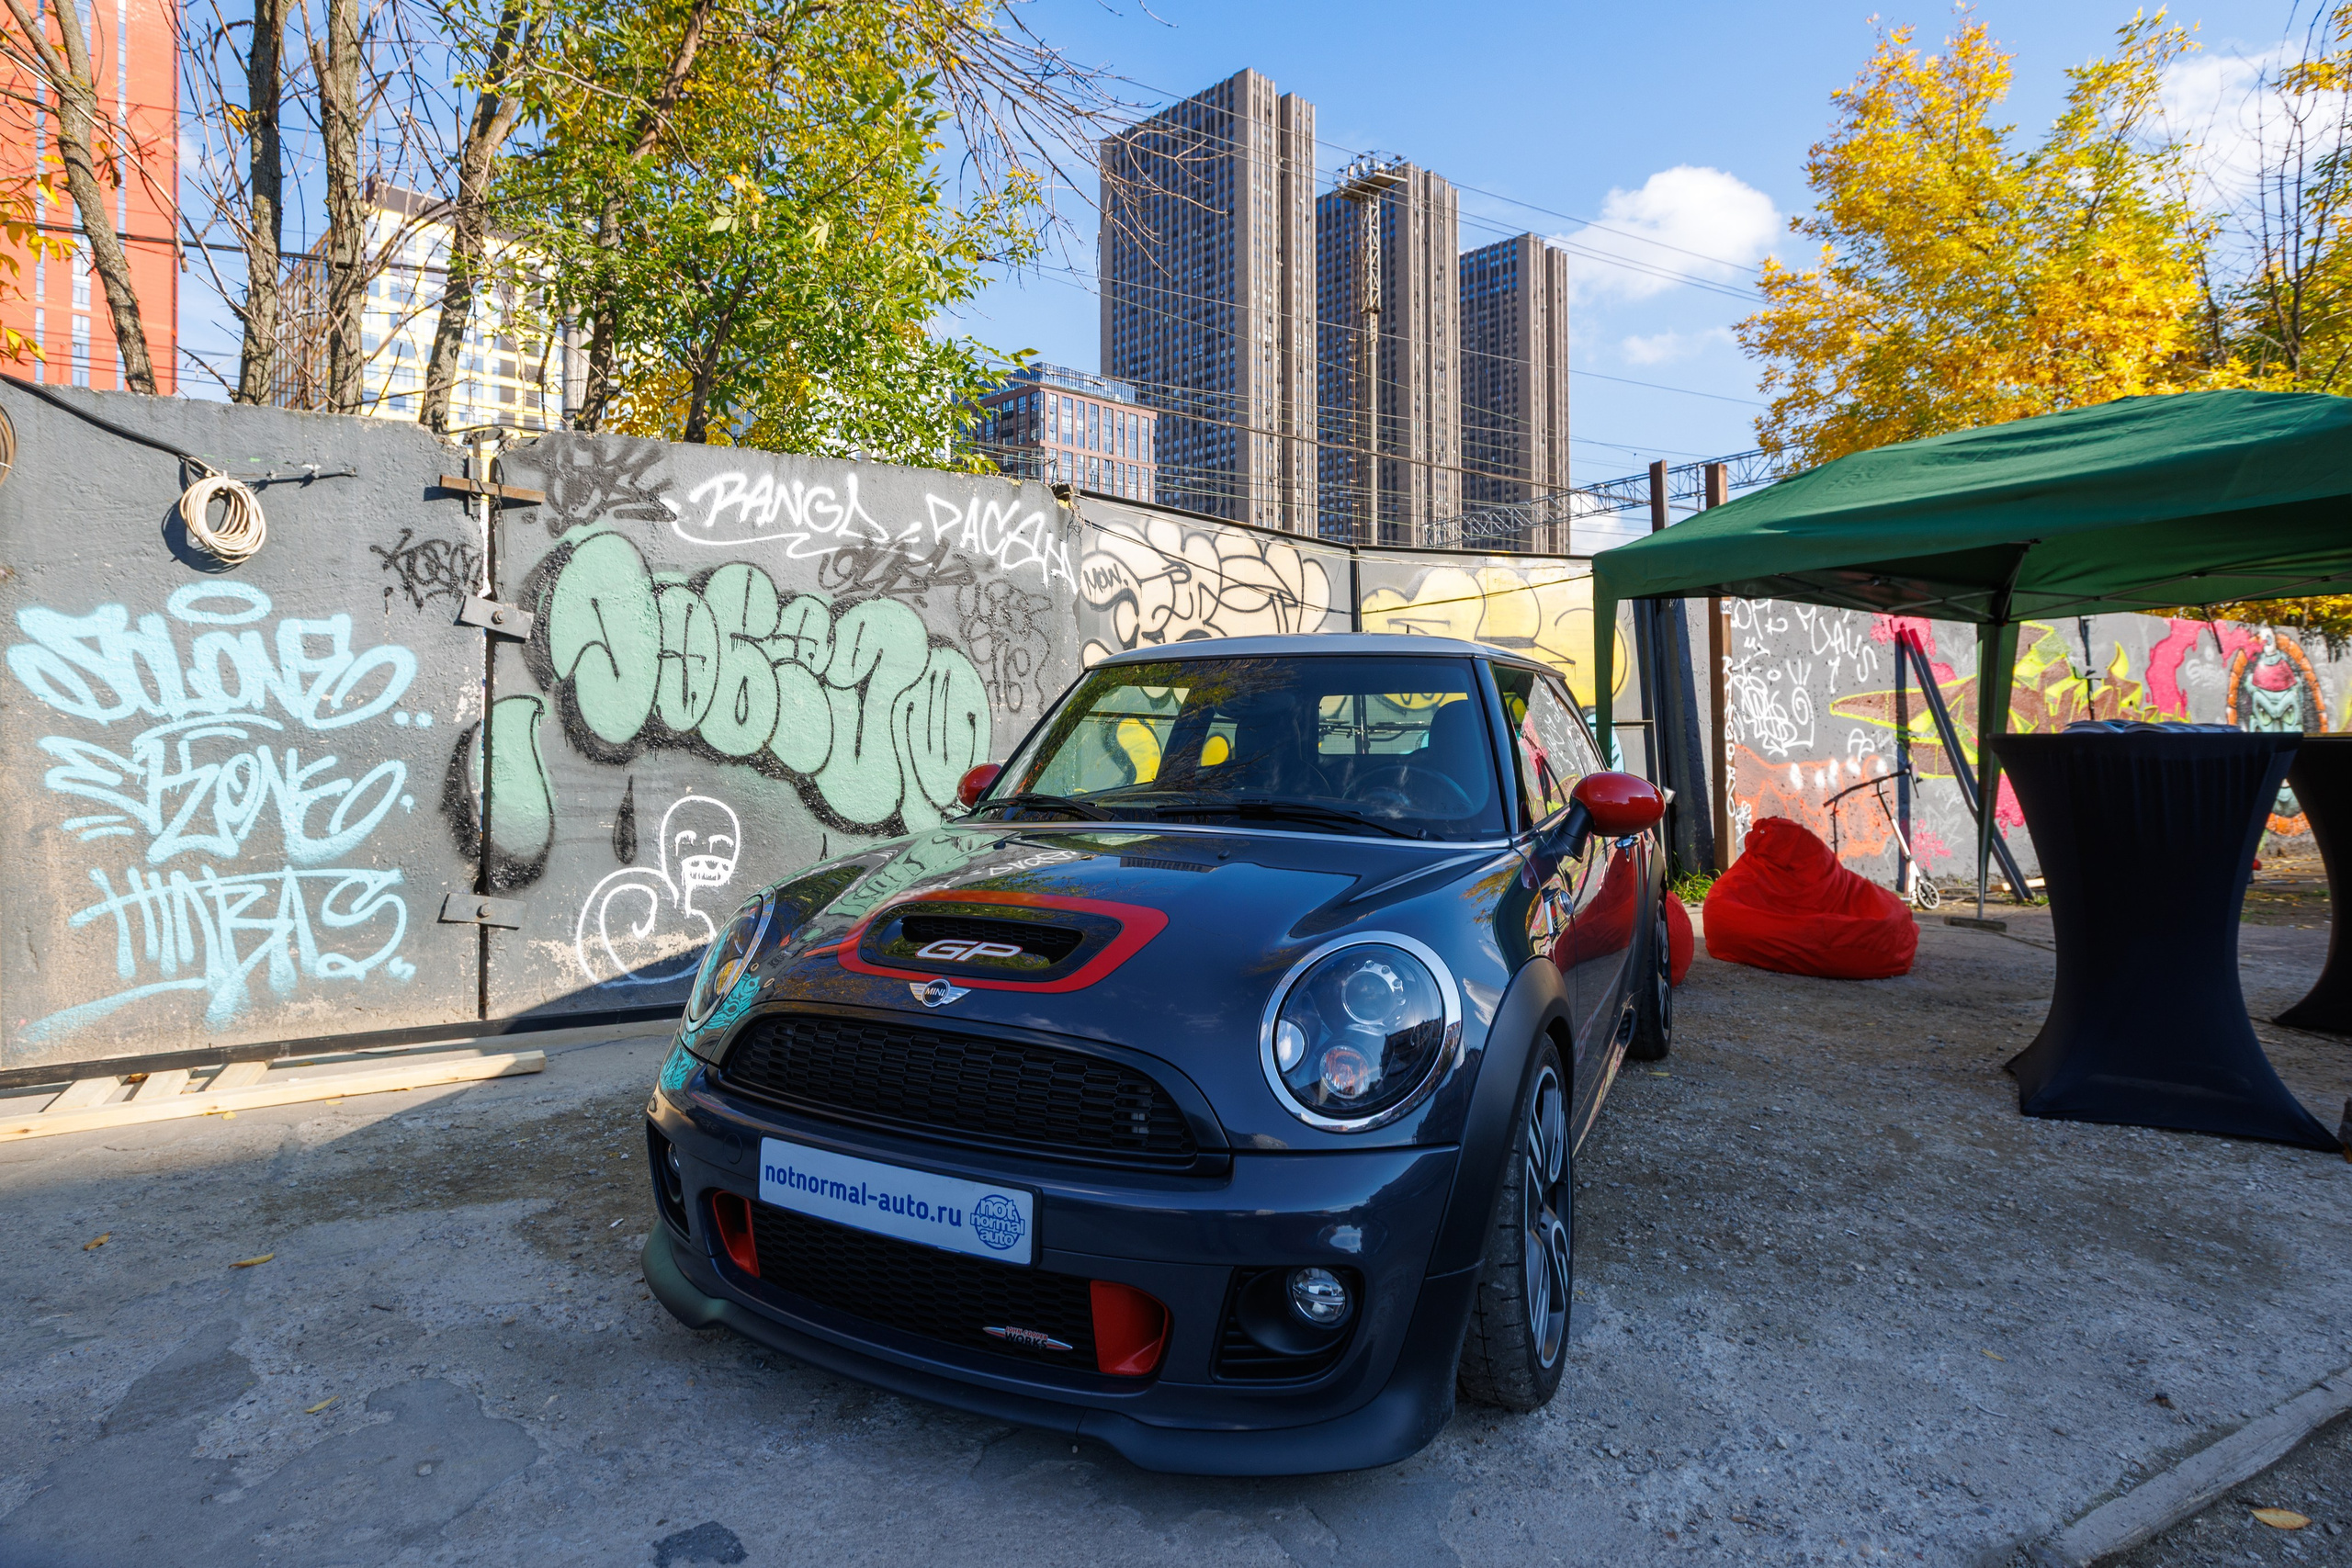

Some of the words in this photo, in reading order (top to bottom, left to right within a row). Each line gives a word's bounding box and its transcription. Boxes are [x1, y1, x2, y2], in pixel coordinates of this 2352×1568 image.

[915, 939, 1023, 962] GP
[924, 987, 946, 998] MINI
[764, 1163, 963, 1228] notnormal-auto.ru
[979, 1198, 1017, 1221] not
[970, 1213, 1025, 1236] normal
[979, 1230, 1016, 1247] auto
[1004, 1332, 1048, 1349] WORKS
[1005, 1325, 1023, 1336] JOHN
[1023, 1329, 1048, 1341] COOPER
